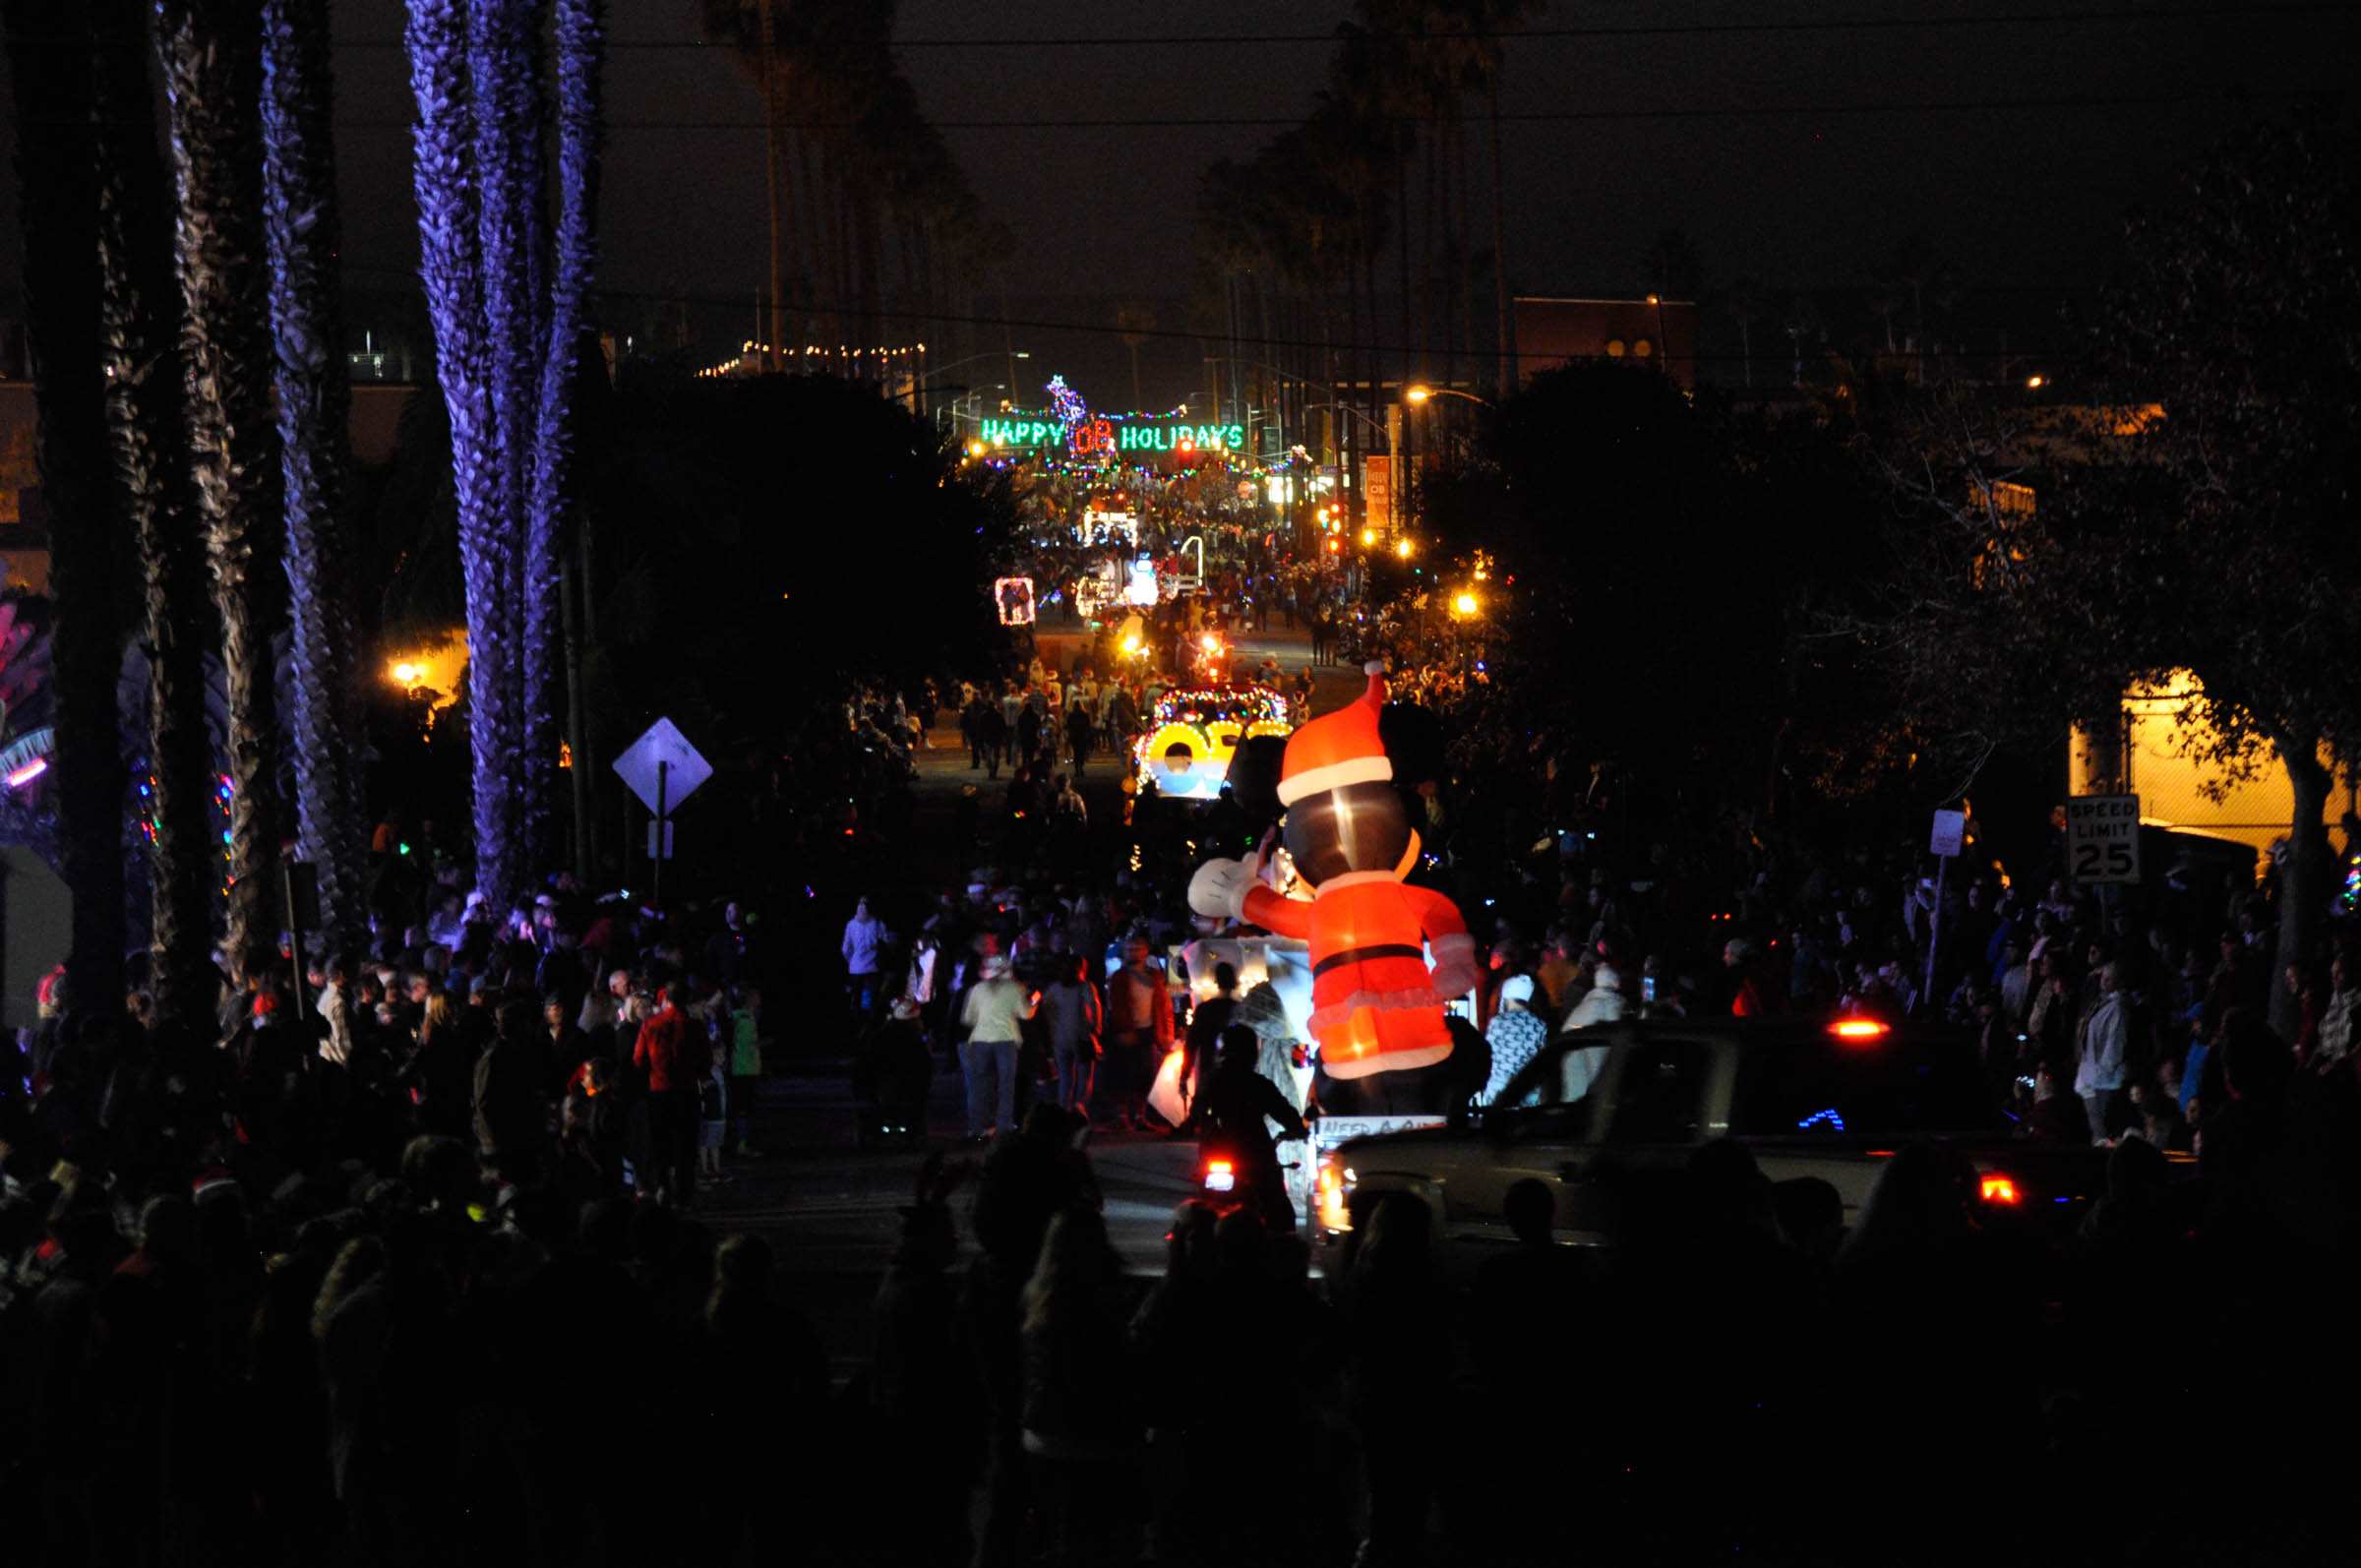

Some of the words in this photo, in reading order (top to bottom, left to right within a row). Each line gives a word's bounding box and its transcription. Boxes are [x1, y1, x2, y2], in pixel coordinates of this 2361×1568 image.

[983, 418, 1065, 446] HAPPY
[1120, 425, 1244, 451] HOLIDAYS
[2072, 802, 2135, 817] SPEED
[2078, 824, 2129, 839] LIMIT
[2077, 845, 2133, 875] 25
